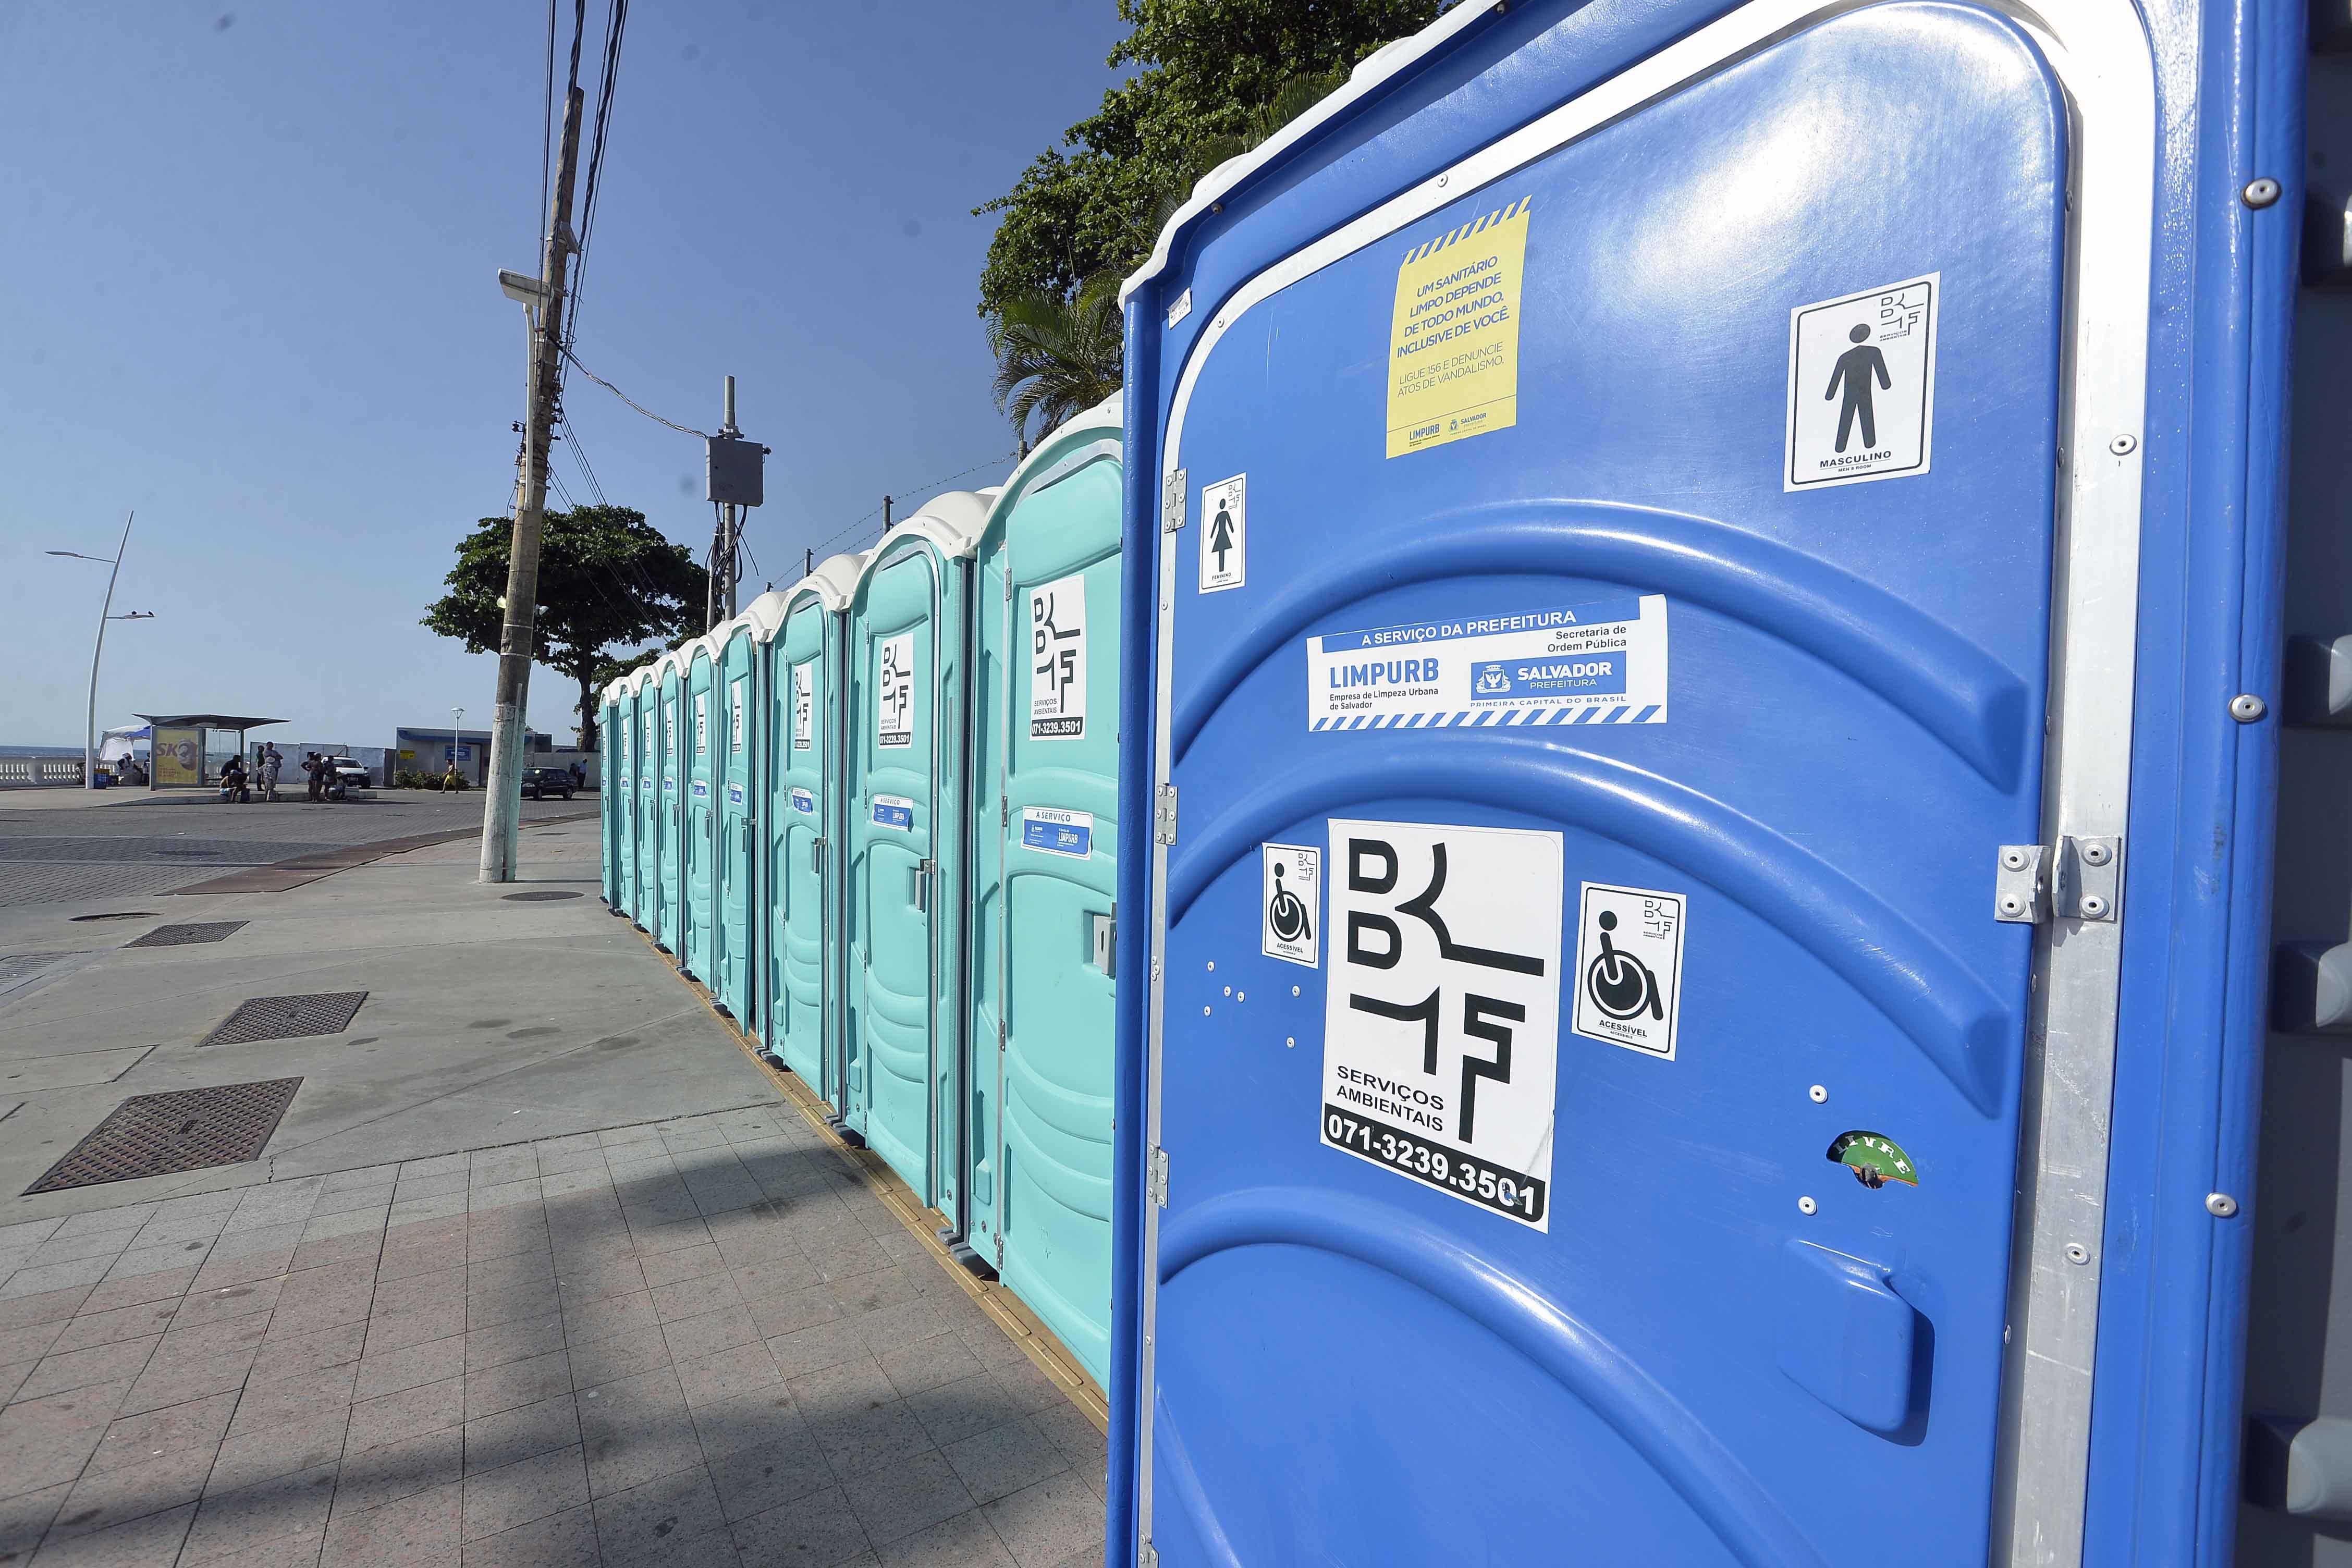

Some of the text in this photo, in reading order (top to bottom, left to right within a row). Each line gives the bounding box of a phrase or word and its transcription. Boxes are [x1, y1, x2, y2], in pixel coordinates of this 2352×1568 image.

[1417, 256, 1498, 297] UM SANITÁRIO
[1410, 272, 1501, 317] LIMPO DEPENDE
[1404, 291, 1504, 338] DE TODO MUNDO.
[1397, 328, 1453, 358] INCLUSIVE
[1455, 321, 1471, 337] DE
[1400, 341, 1503, 384] LIGUE 156 E DENUNCIE
[1398, 356, 1504, 398] ATOS DE VANDALISMO.
[1461, 412, 1487, 424] SALVADOR
[1410, 423, 1440, 440] LIMPURB
[1820, 451, 1891, 468] MASCULINO
[1362, 610, 1577, 646] A SERVIÇO DA PREFEITURA
[1556, 626, 1626, 640] Secretaria de
[1548, 638, 1626, 652] Ordem Pública
[1330, 658, 1439, 689] LIMPURB
[1517, 662, 1613, 681] SALVADOR
[1530, 679, 1597, 689] PREFEITURA
[1034, 698, 1057, 707] SERVIÇOS
[1330, 693, 1361, 702] Empresa
[1374, 690, 1406, 699] Limpeza
[1409, 688, 1439, 696] Urbana
[1341, 701, 1373, 709] Salvador
[1032, 720, 1081, 734] 071-3239.3501
[1042, 812, 1071, 823] SERVIÇO
[1058, 832, 1078, 844] LIMPURB
[1277, 943, 1303, 953] ACESSÍVEL
[1599, 1020, 1647, 1037] ACESSÍVEL
[1610, 1031, 1633, 1039] ACCESSIBLE
[1337, 1065, 1444, 1110] SERVIÇOS
[1337, 1085, 1443, 1132] AMBIENTAIS
[1833, 1135, 1910, 1174] LIVRE
[1328, 1114, 1534, 1215] 071-3239.3501
